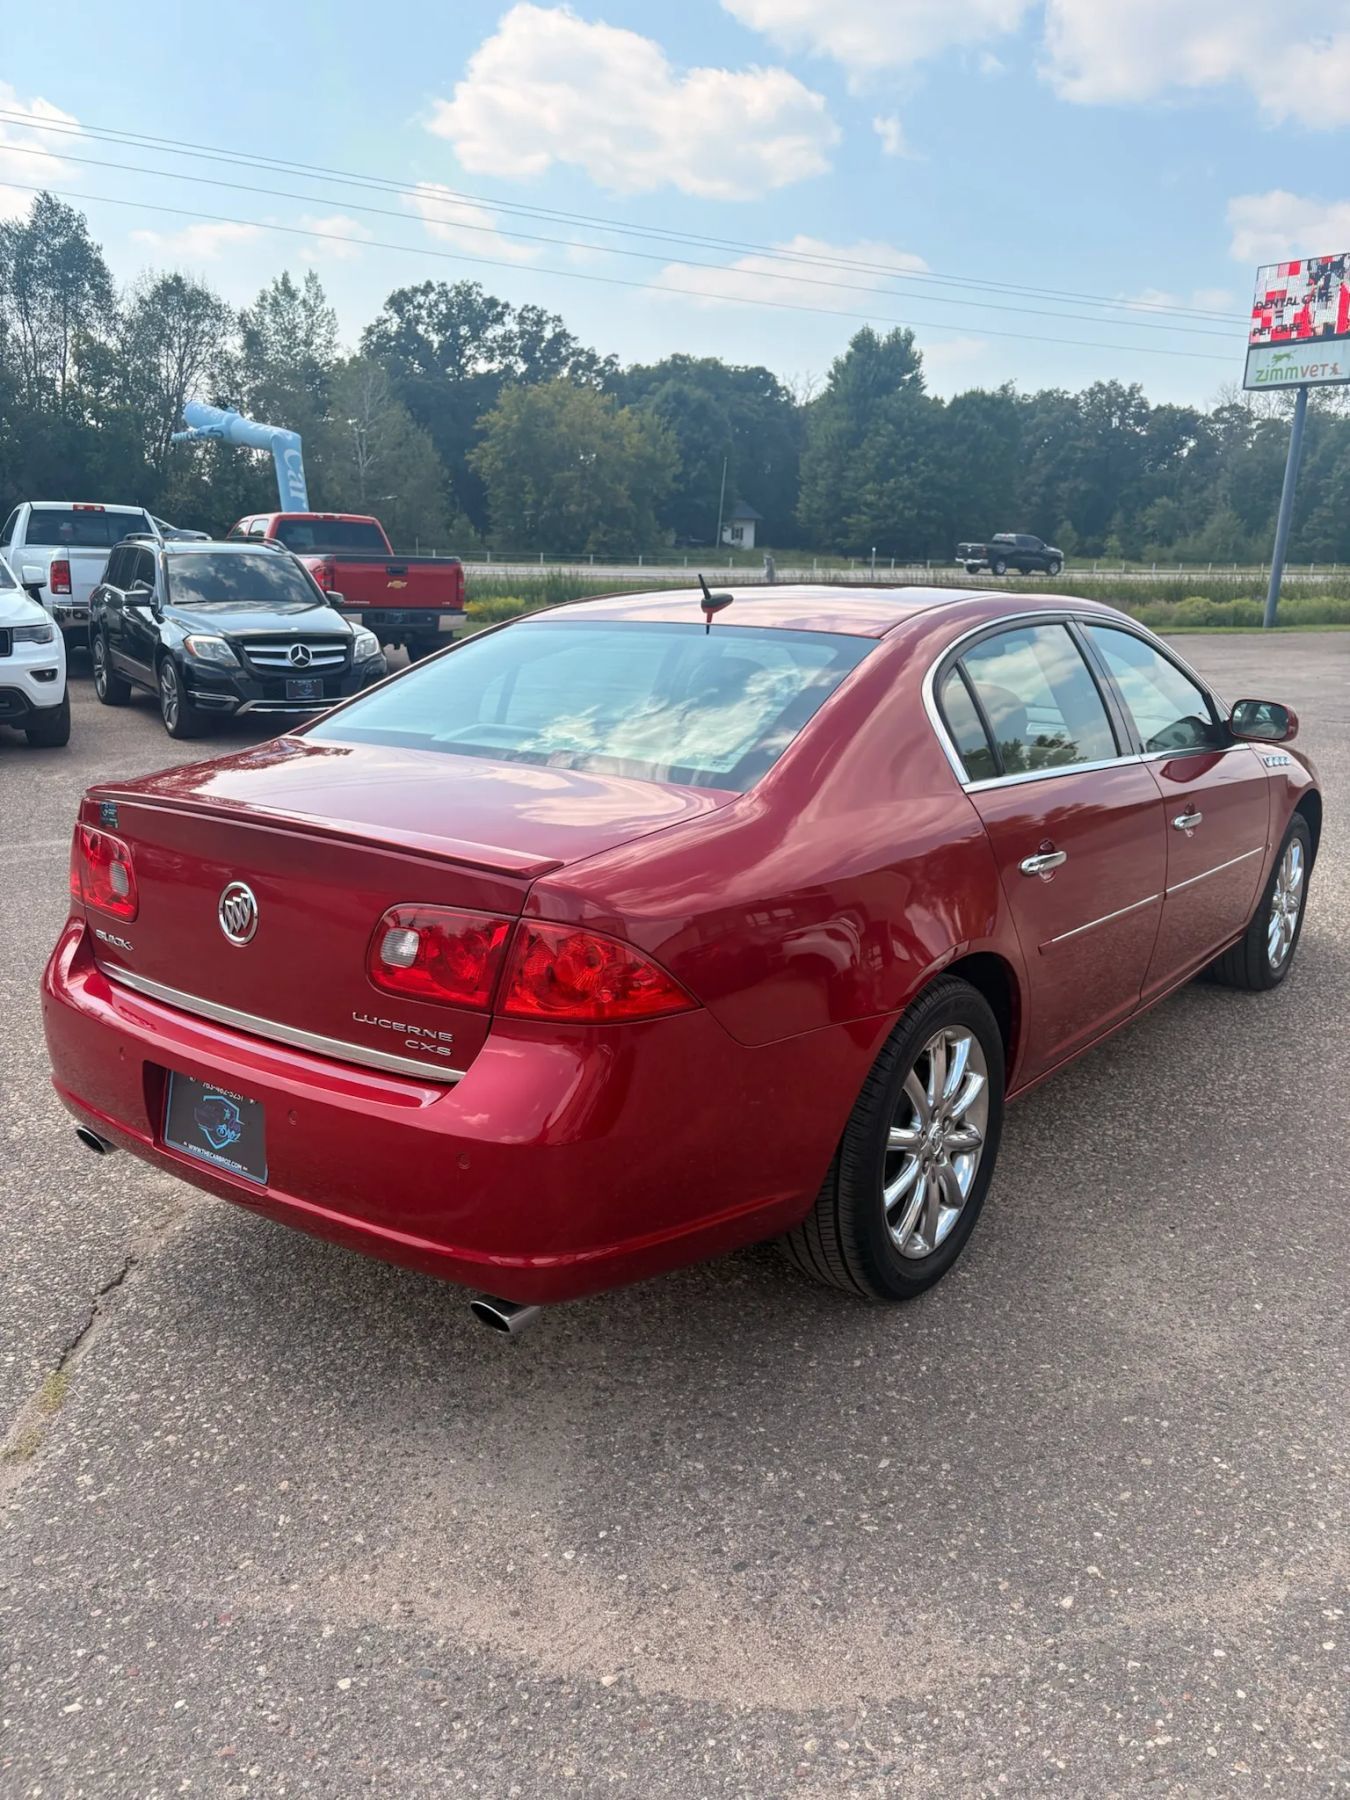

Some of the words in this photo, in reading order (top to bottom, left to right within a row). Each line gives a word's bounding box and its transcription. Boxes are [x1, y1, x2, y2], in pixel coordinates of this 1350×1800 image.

[1254, 296, 1300, 310] DENTAL
[1252, 326, 1272, 336] PET
[95, 929, 134, 951] BUICK
[352, 1011, 453, 1042] LUCERNE
[405, 1039, 452, 1056] CXS
